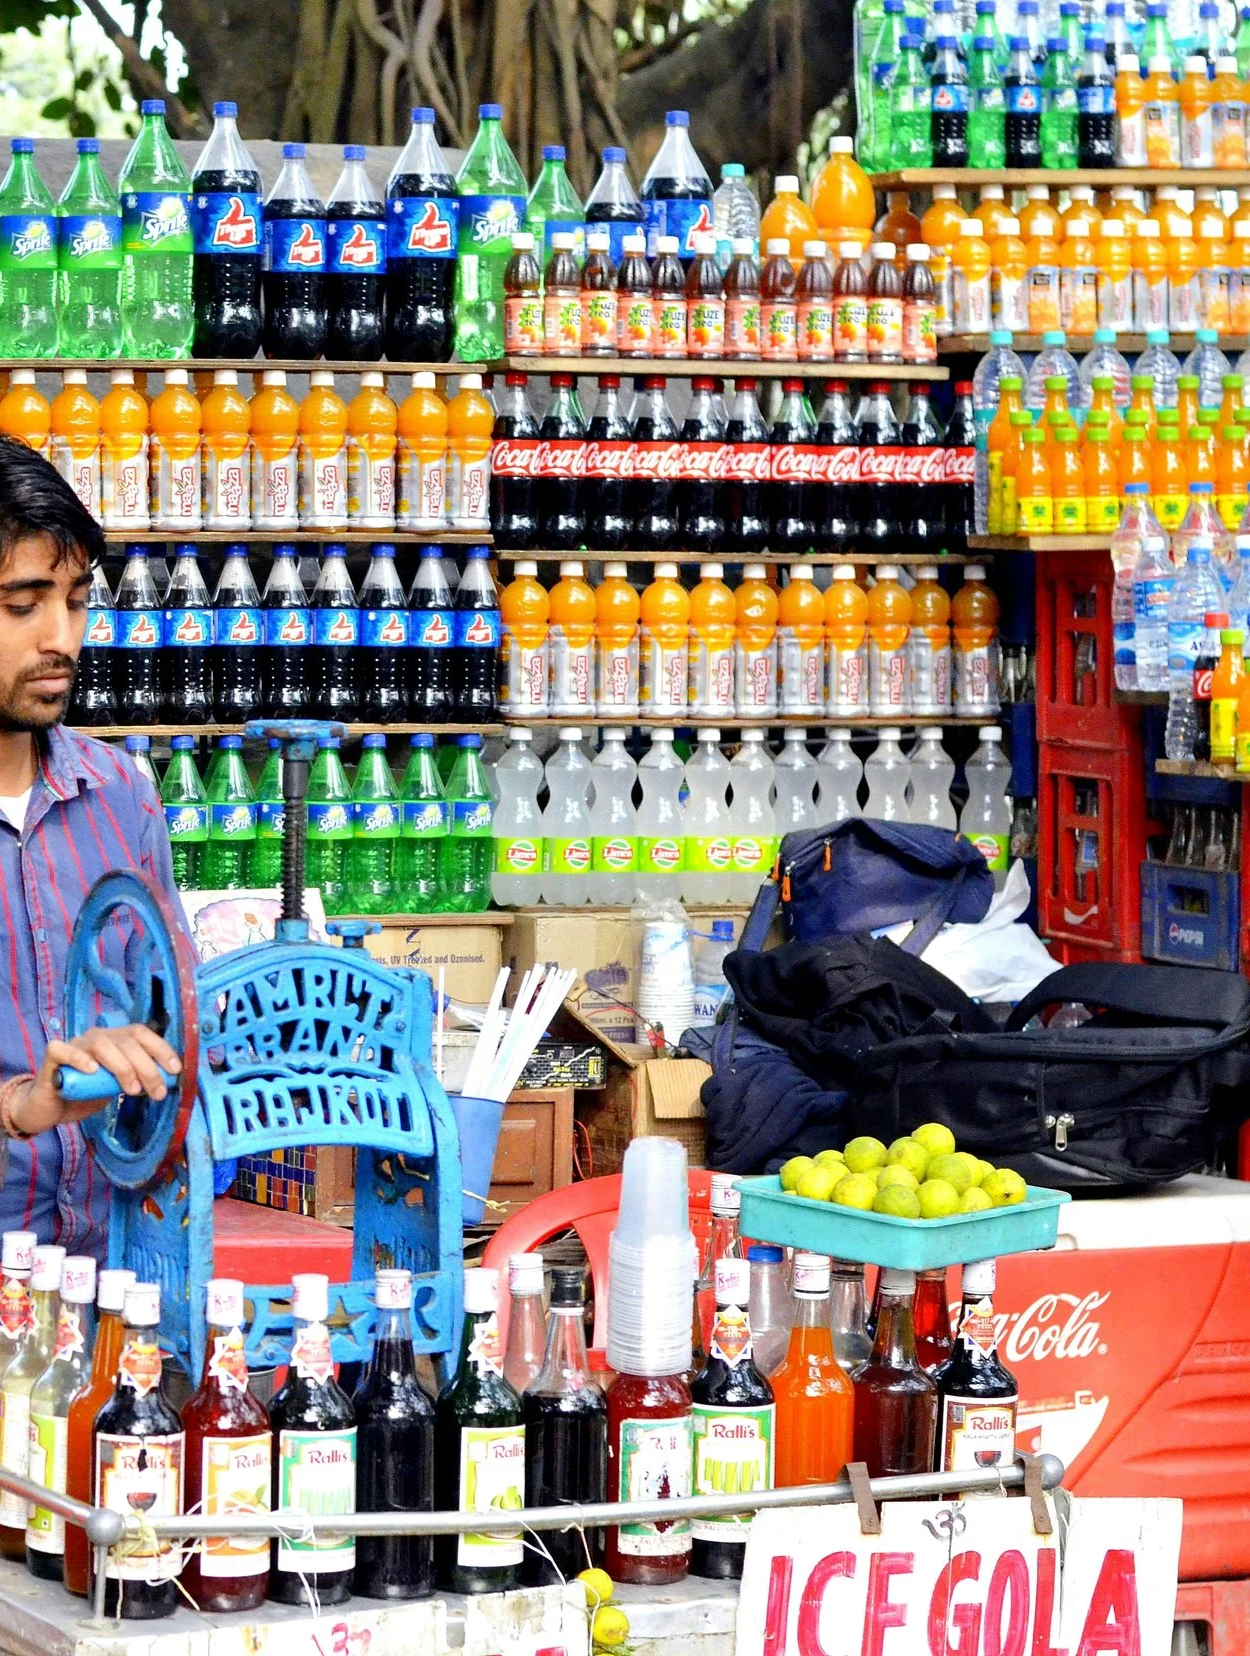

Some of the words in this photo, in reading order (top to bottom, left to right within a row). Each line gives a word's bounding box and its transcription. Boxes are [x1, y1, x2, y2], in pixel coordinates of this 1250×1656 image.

[143, 211, 190, 239] Sprite
[473, 216, 519, 241] Sprite
[13, 233, 50, 257] Sprite
[73, 233, 113, 257] Sprite
[123, 467, 139, 517] maaza
[181, 467, 195, 517] maaza
[226, 467, 242, 517] maaza
[273, 467, 287, 517] maaza
[323, 465, 339, 513] maaza
[378, 466, 395, 513] maaza
[429, 469, 445, 518] maaza
[530, 655, 543, 704] maaza
[614, 656, 629, 704] maaza
[670, 656, 685, 704] maaza
[754, 657, 769, 704] maaza
[890, 657, 905, 704] maaza
[171, 815, 200, 834] Sprite
[225, 817, 253, 832] Sprite
[319, 816, 348, 833] Sprite
[366, 815, 394, 833] Sprite
[415, 816, 443, 833] Sprite
[466, 816, 491, 832] Sprite
[1177, 930, 1204, 945] PEPSI
[390, 955, 401, 964] UV
[404, 955, 432, 964] Treted
[435, 954, 448, 963] and
[450, 954, 485, 963] Ozonised.
[222, 967, 397, 1033] AMRIT
[695, 1004, 718, 1016] WAN
[227, 1018, 385, 1064] BRAND
[234, 1084, 411, 1134] RAJKOT
[949, 1290, 1111, 1362] Ca-Cola
[712, 1417, 755, 1438] Ralli's
[970, 1416, 1009, 1430] Ralli's
[309, 1449, 348, 1464] Ralli's
[493, 1444, 525, 1459] Ralli's
[763, 1550, 916, 1656] ICE
[927, 1548, 1141, 1656] GOLA
